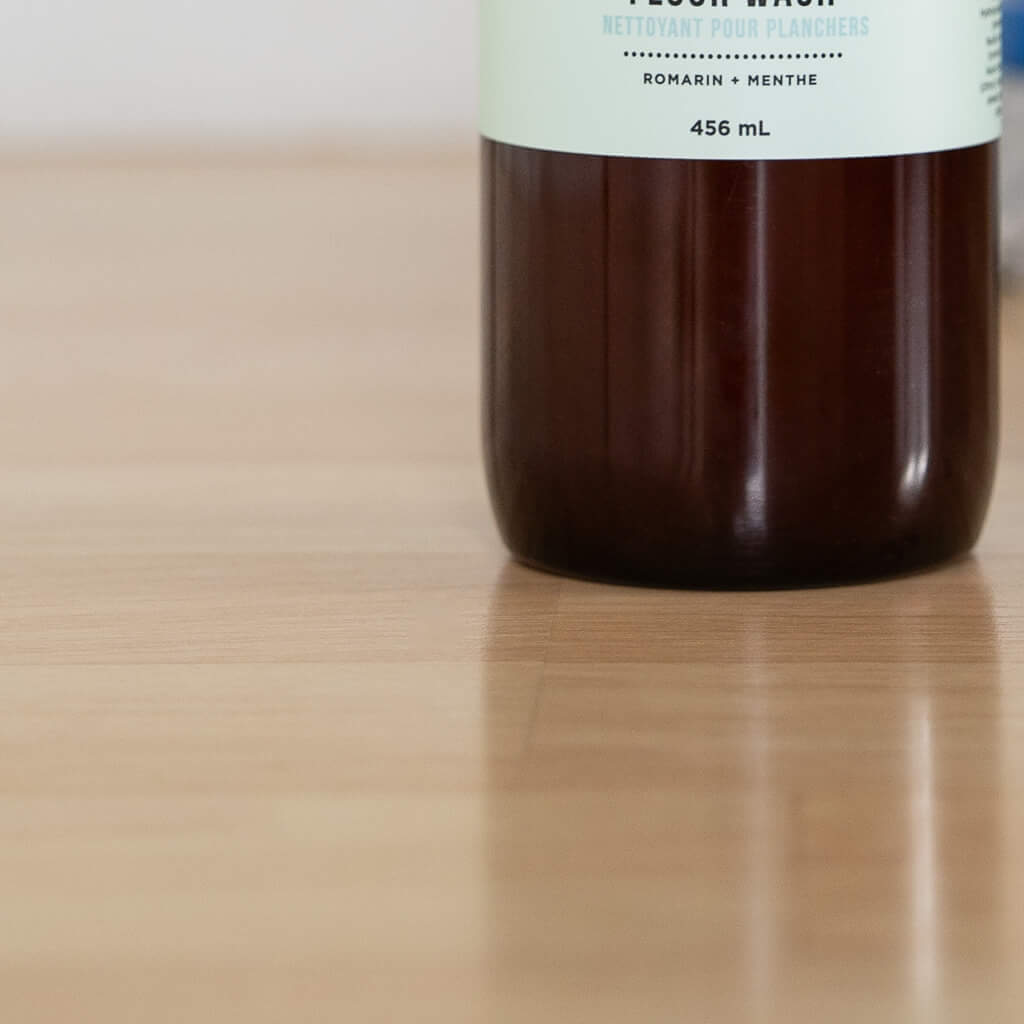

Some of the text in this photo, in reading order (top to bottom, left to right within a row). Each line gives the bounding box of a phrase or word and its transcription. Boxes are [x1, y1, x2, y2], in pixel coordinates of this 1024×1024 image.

[602, 14, 870, 39] NETTOYANT POUR PLANCHERS
[643, 72, 817, 87] ROMARIN + MENTHE
[689, 119, 771, 137] 456 mL
